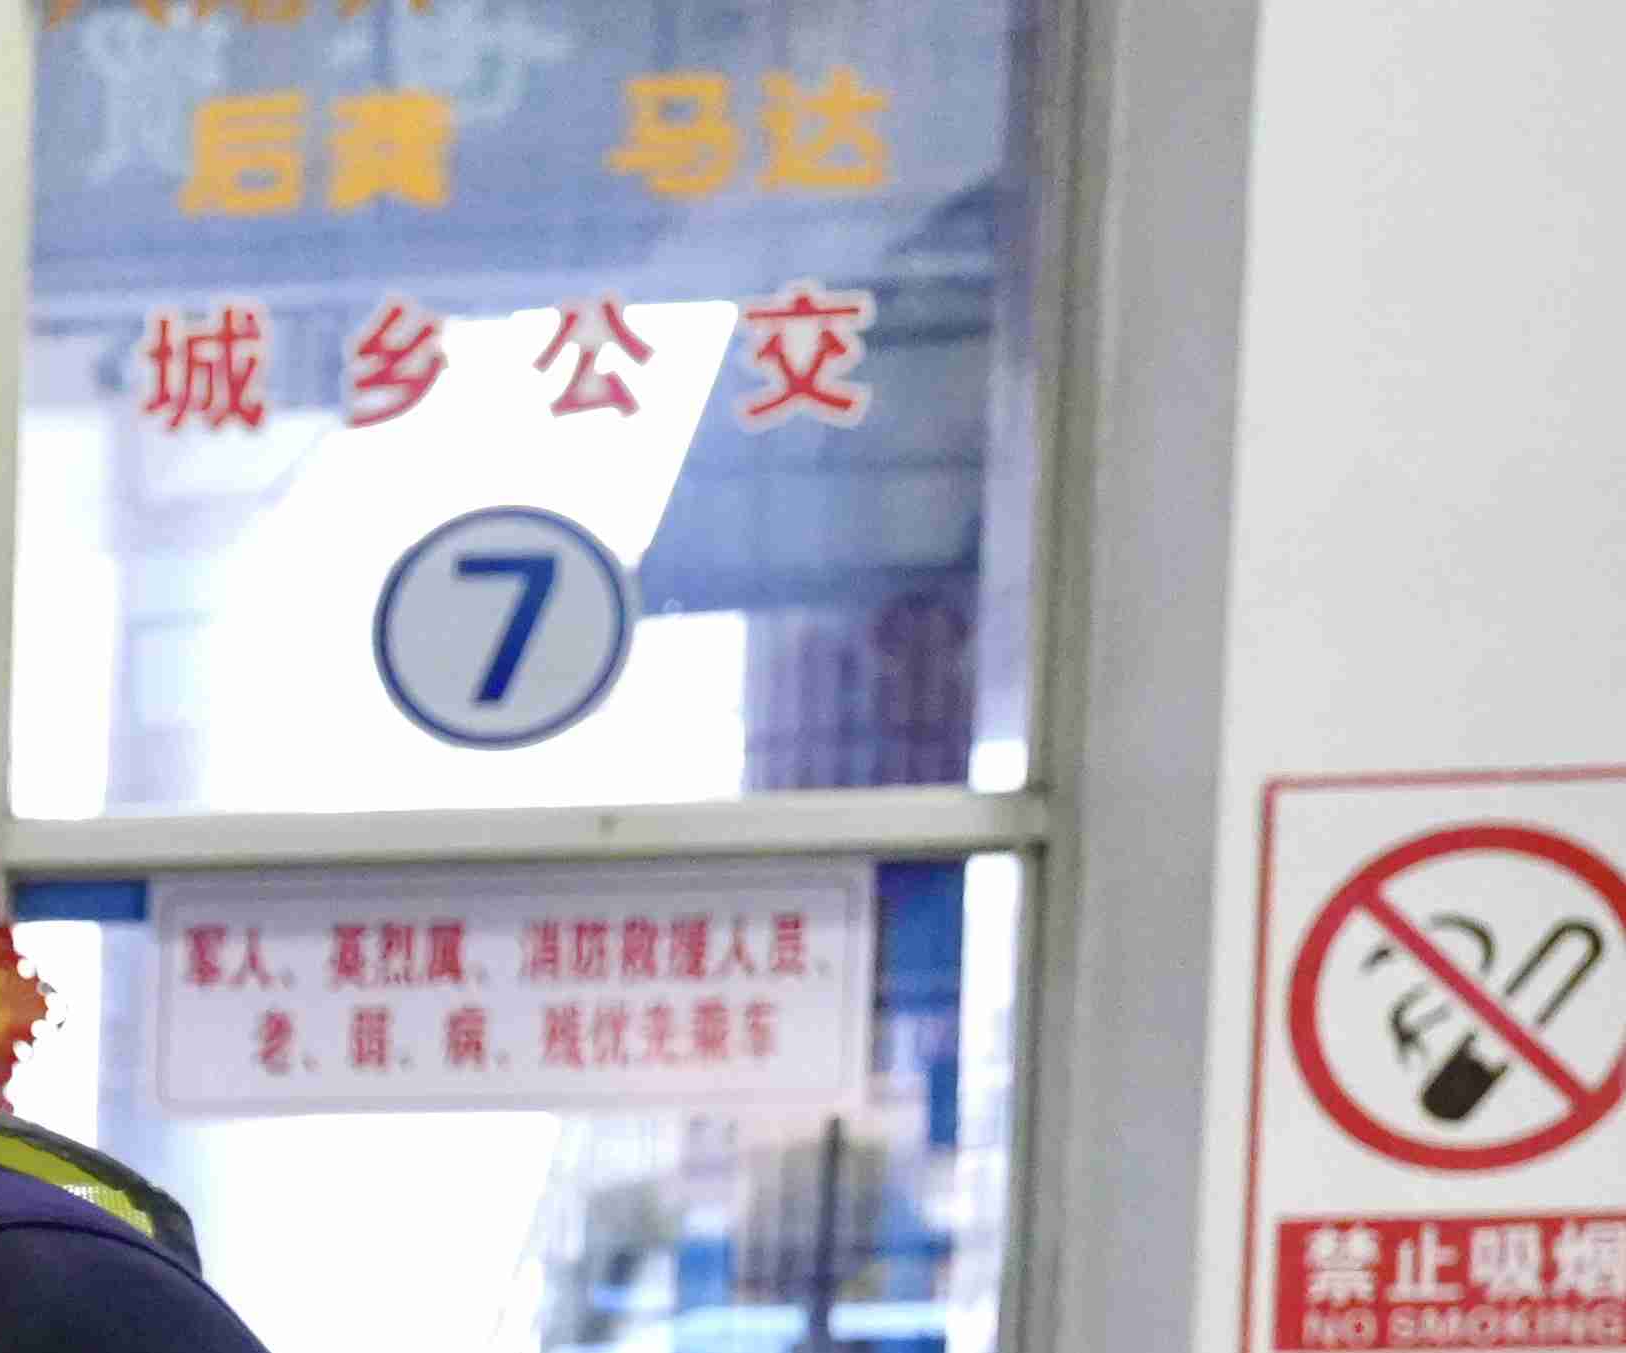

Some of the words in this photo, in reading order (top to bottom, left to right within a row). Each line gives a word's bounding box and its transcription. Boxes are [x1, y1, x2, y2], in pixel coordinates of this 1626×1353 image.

[611, 68, 889, 200] 马达
[142, 293, 862, 432] 城乡公交
[455, 553, 558, 706] 7
[1303, 1308, 1378, 1347] NO
